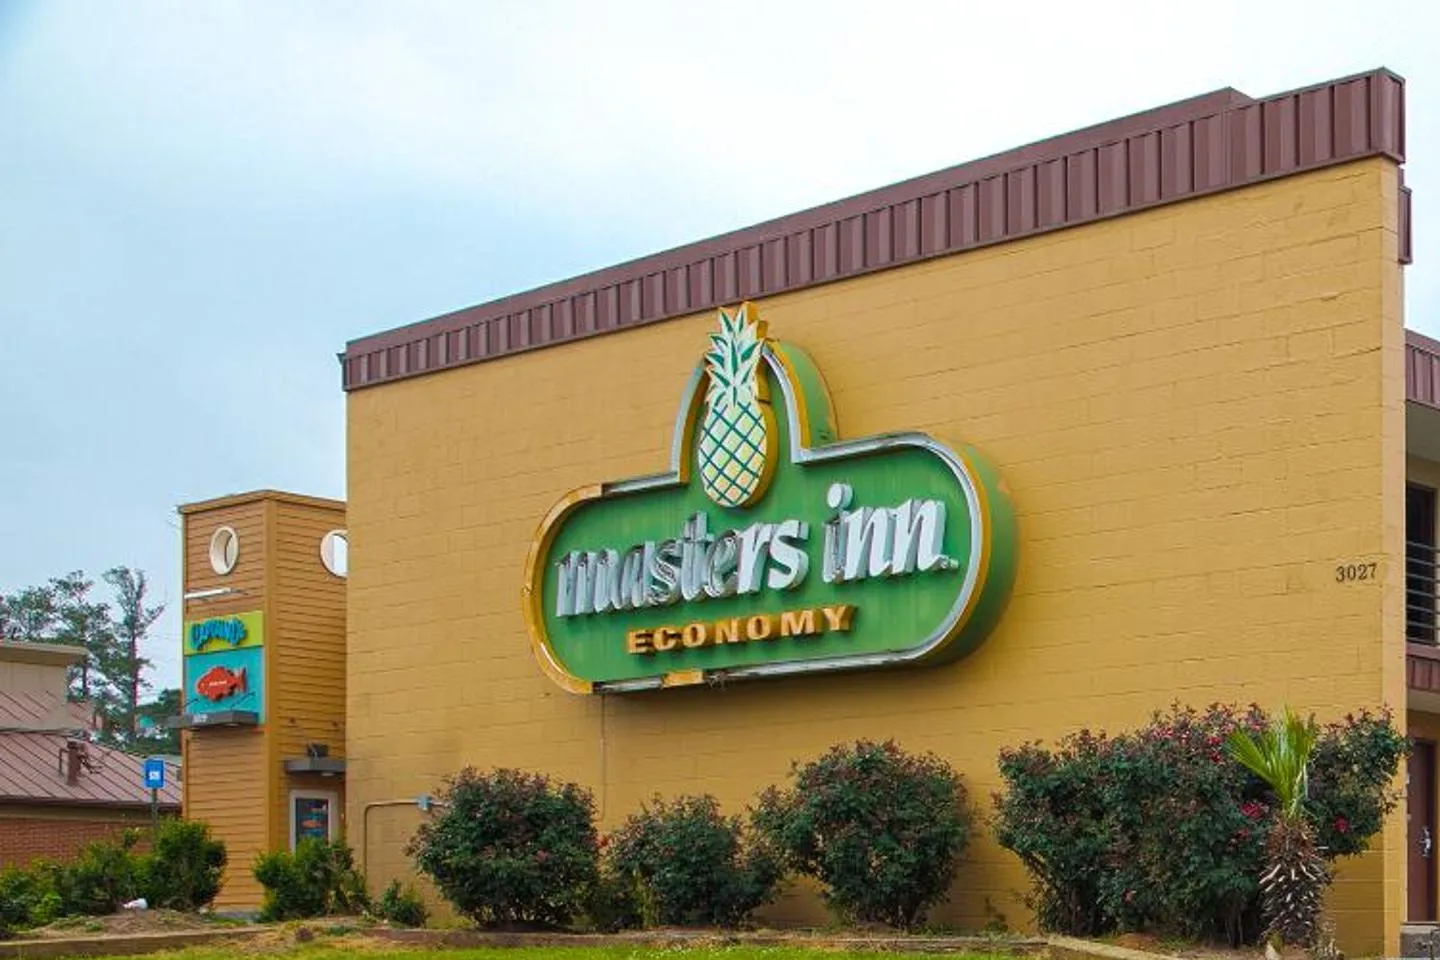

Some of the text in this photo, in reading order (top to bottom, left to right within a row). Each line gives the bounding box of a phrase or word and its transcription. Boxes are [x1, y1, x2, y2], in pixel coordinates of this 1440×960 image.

[555, 483, 950, 617] masters inn
[1335, 562, 1377, 583] 3027
[628, 605, 853, 655] ECONOMY
